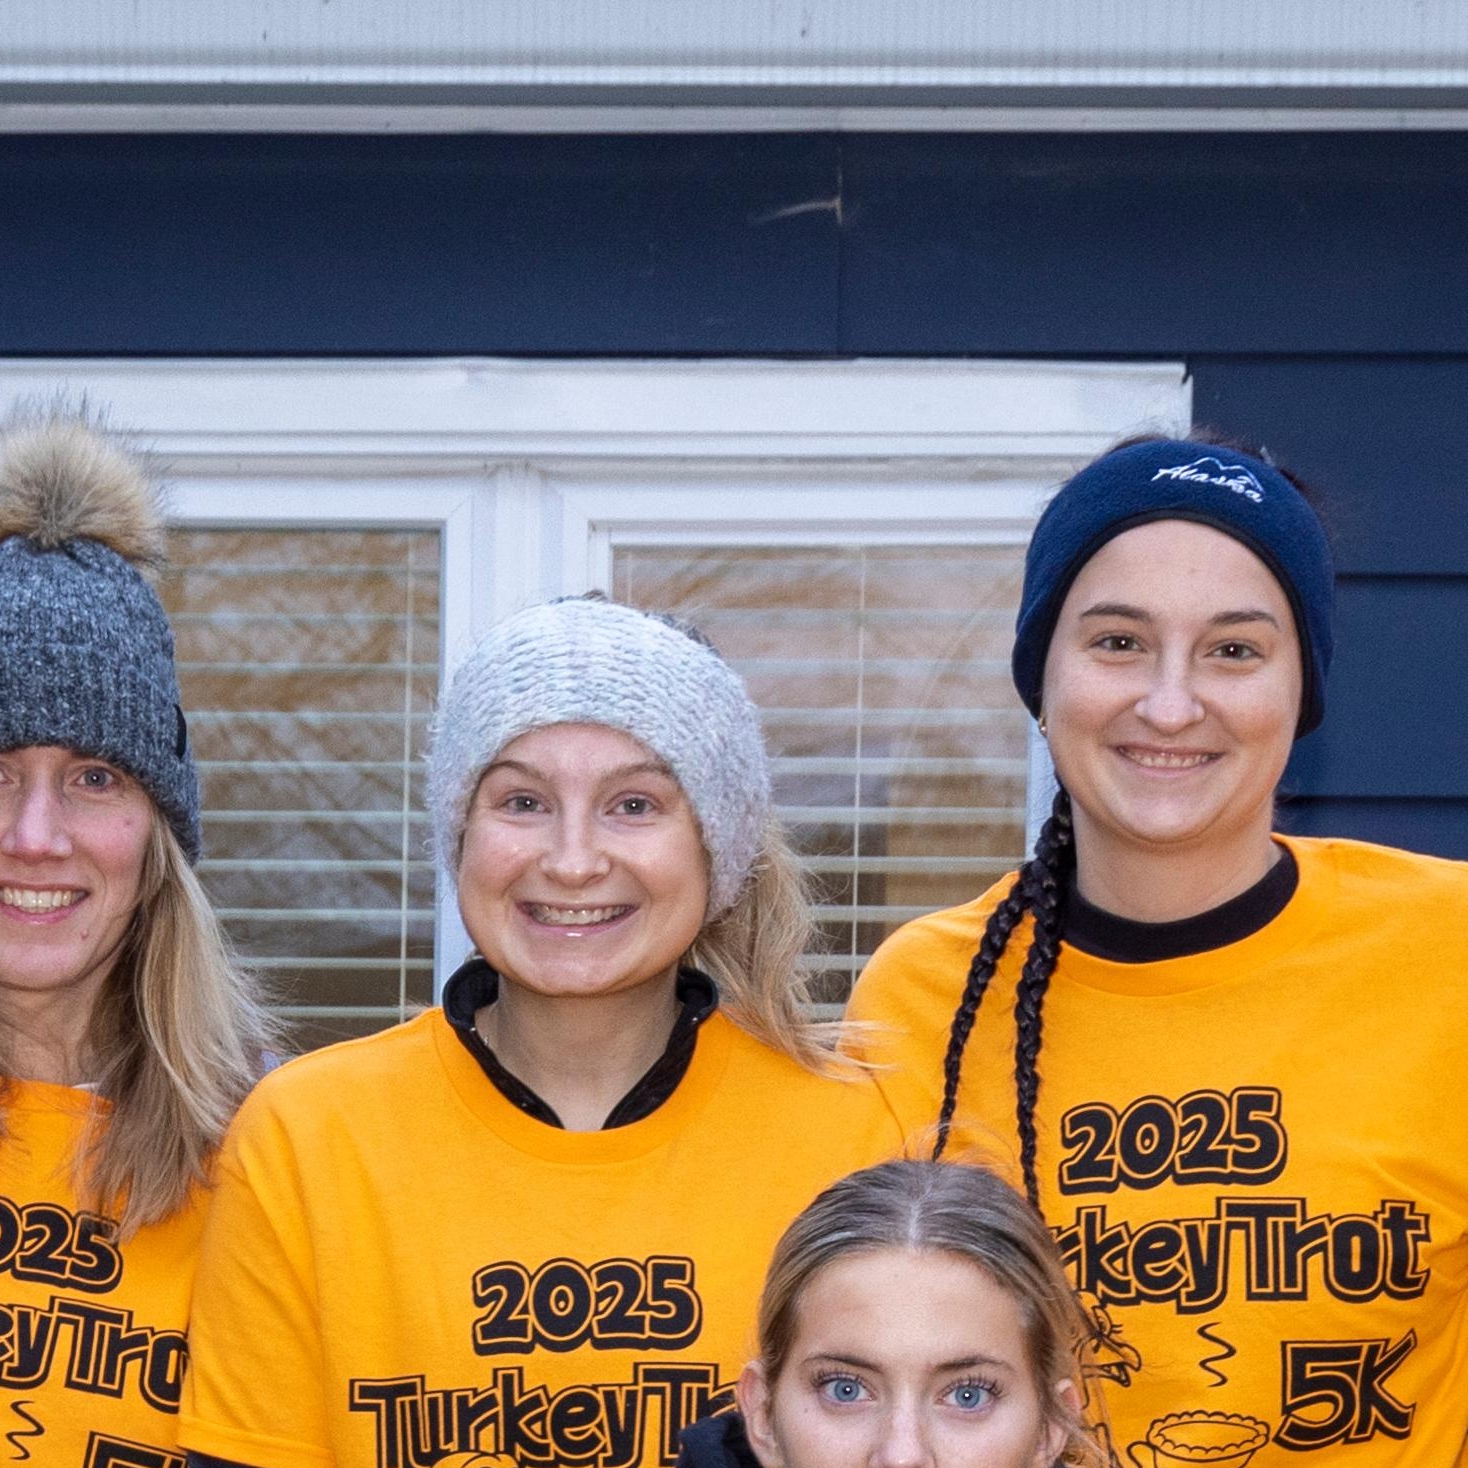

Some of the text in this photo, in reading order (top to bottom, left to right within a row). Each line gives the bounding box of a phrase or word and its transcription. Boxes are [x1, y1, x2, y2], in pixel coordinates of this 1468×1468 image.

[1151, 464, 1263, 503] Alaska
[1059, 1086, 1287, 1194] 2025
[473, 1256, 702, 1355] 2025
[1273, 1330, 1418, 1451] 5K
